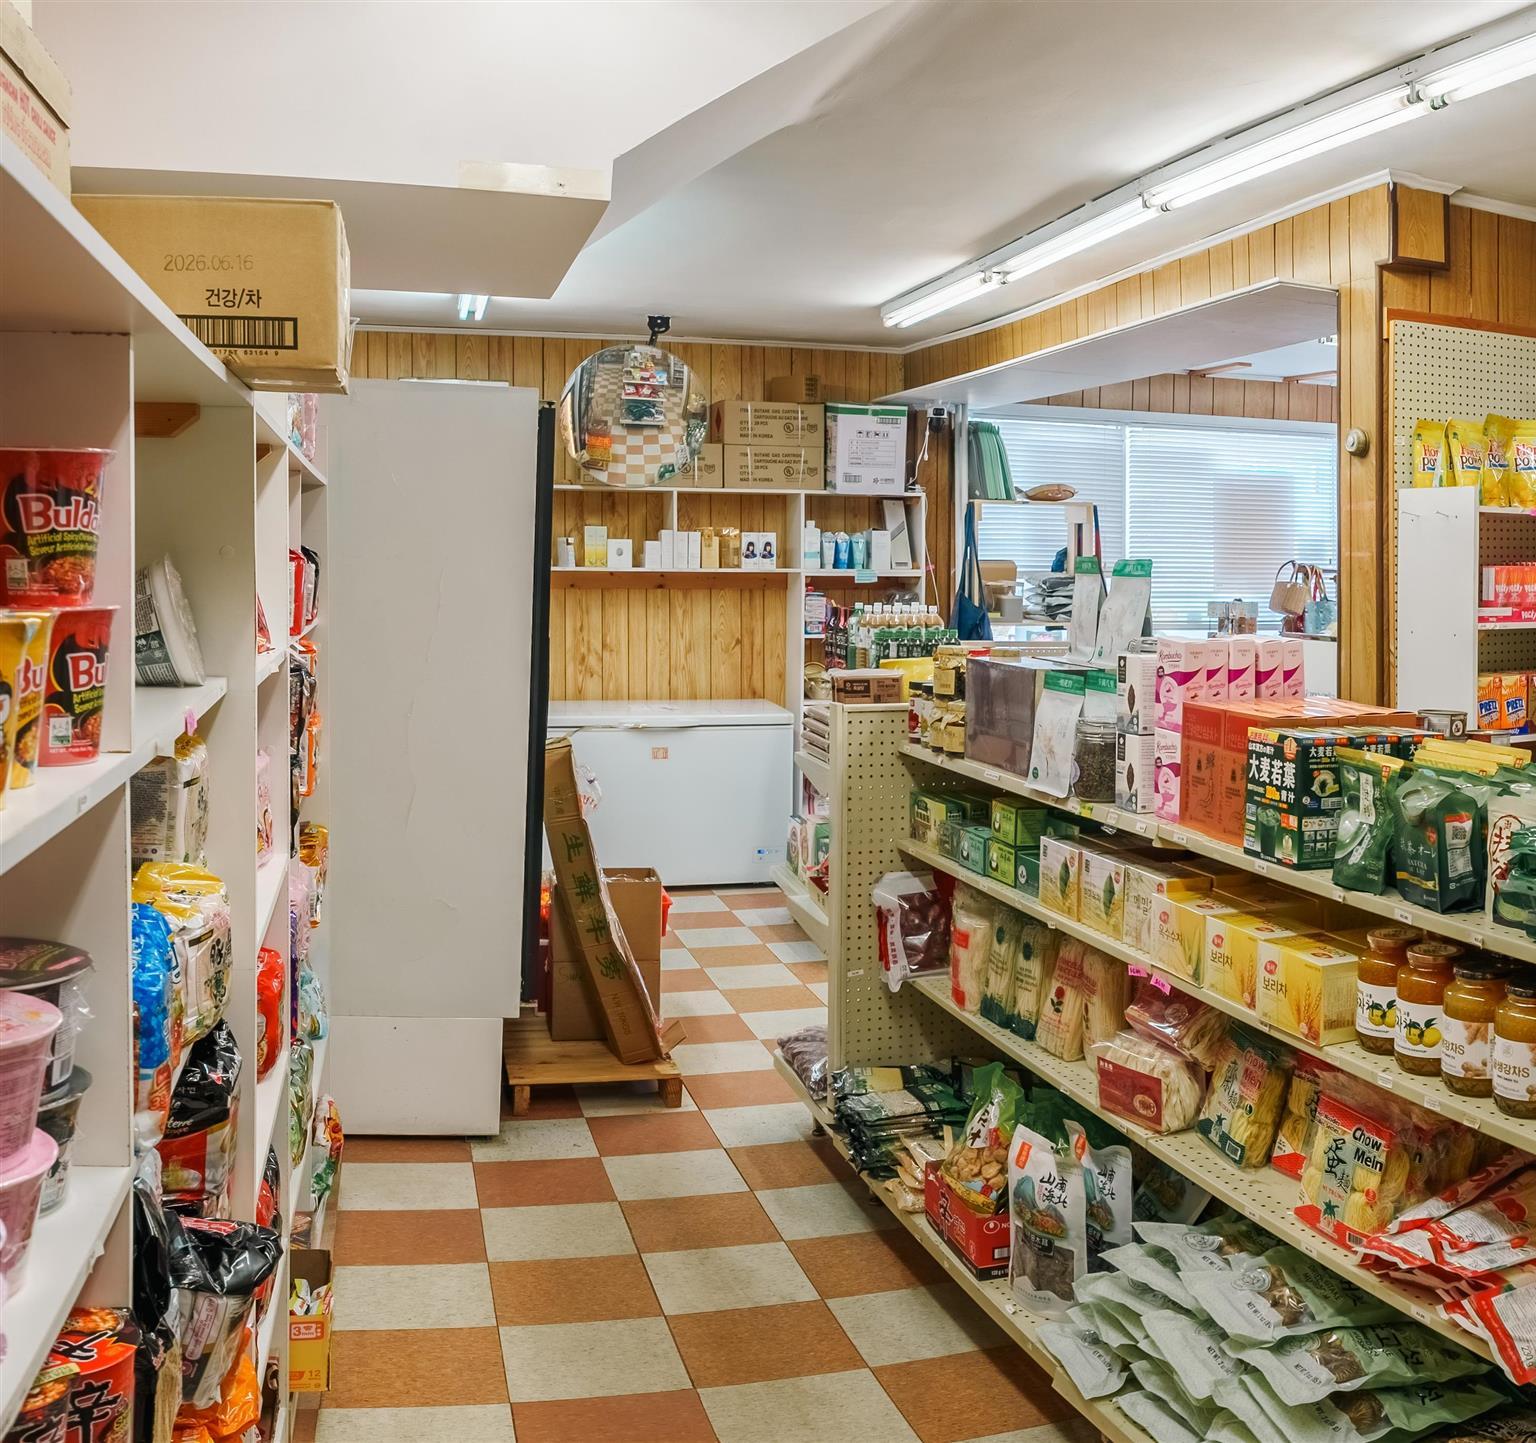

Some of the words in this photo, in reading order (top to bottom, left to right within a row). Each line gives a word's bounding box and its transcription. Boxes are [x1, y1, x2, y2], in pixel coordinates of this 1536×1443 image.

[205, 288, 262, 309] 건강/차
[1159, 649, 1183, 661] Kombucha
[1479, 699, 1498, 714] PRETZ
[1506, 698, 1524, 713] PRETZ
[1210, 951, 1234, 970] 보리차
[1262, 977, 1288, 998] 보리차
[1352, 1127, 1382, 1151] Chow
[1353, 1147, 1383, 1172] Mein
